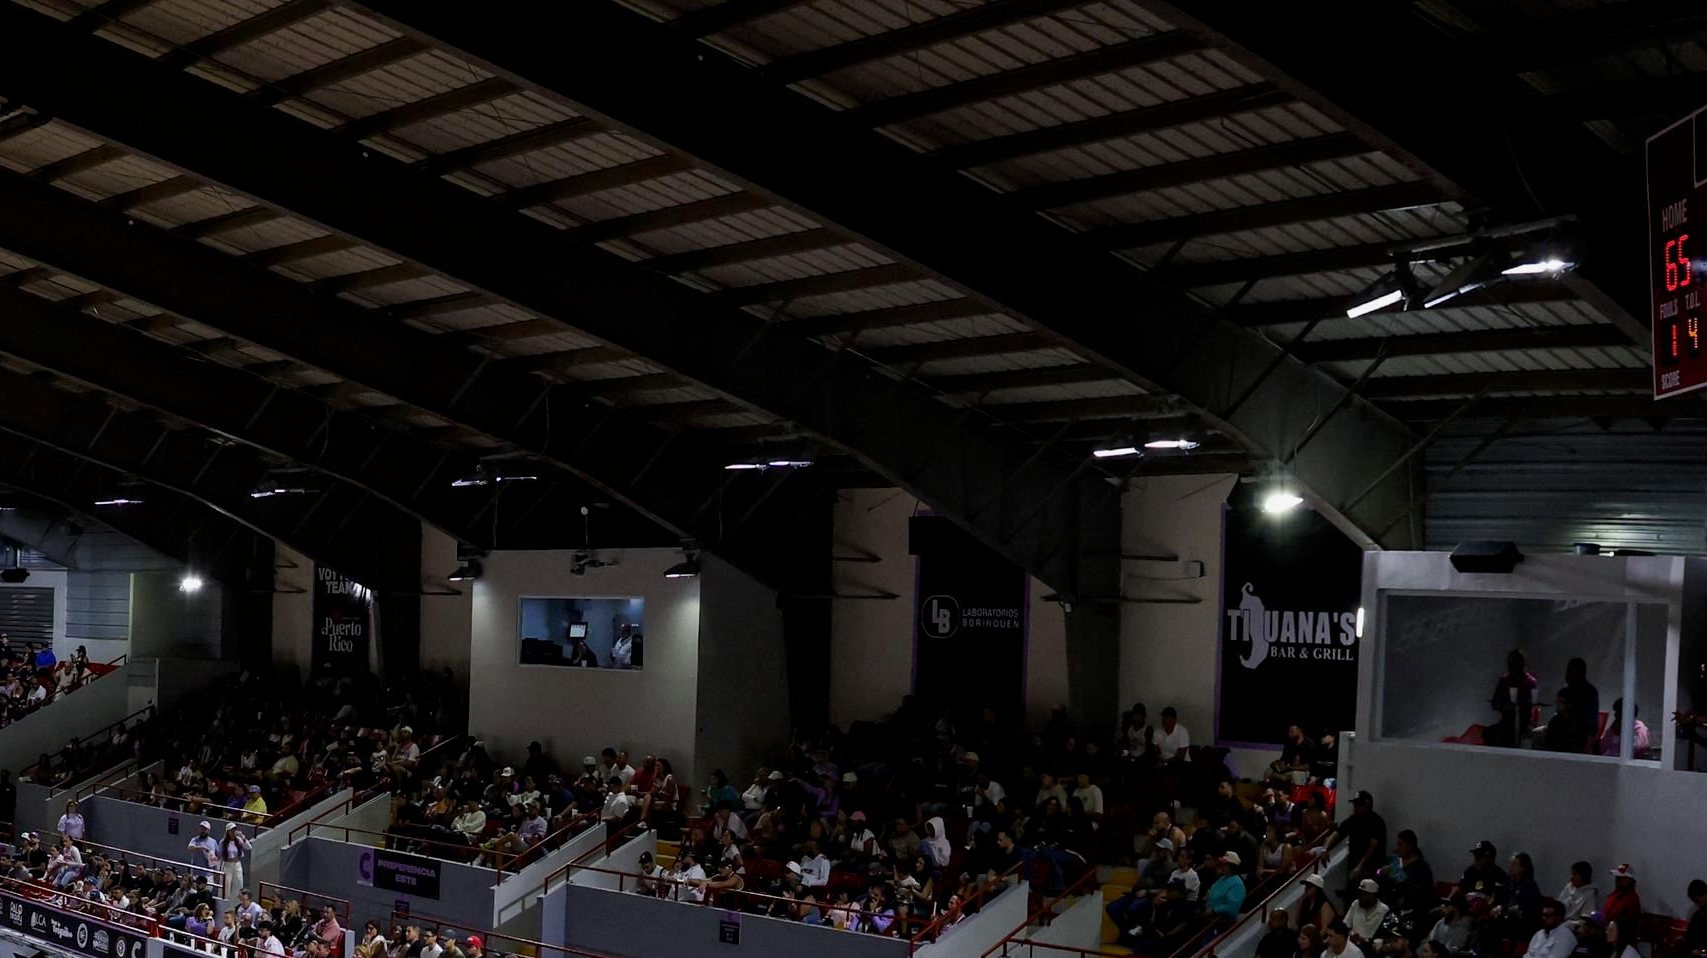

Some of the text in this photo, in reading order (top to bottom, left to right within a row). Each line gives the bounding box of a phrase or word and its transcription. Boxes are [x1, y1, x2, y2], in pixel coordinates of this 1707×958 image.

[1661, 197, 1688, 232] HOME
[1664, 233, 1692, 292] 65
[1687, 316, 1699, 350] 4
[962, 608, 1019, 618] LABORATORIOS
[323, 617, 362, 636] Puerto
[962, 617, 1019, 629] BORINQUEN
[328, 634, 353, 652] Rico
[1270, 645, 1296, 660] BAR
[1312, 647, 1354, 661] GRILL
